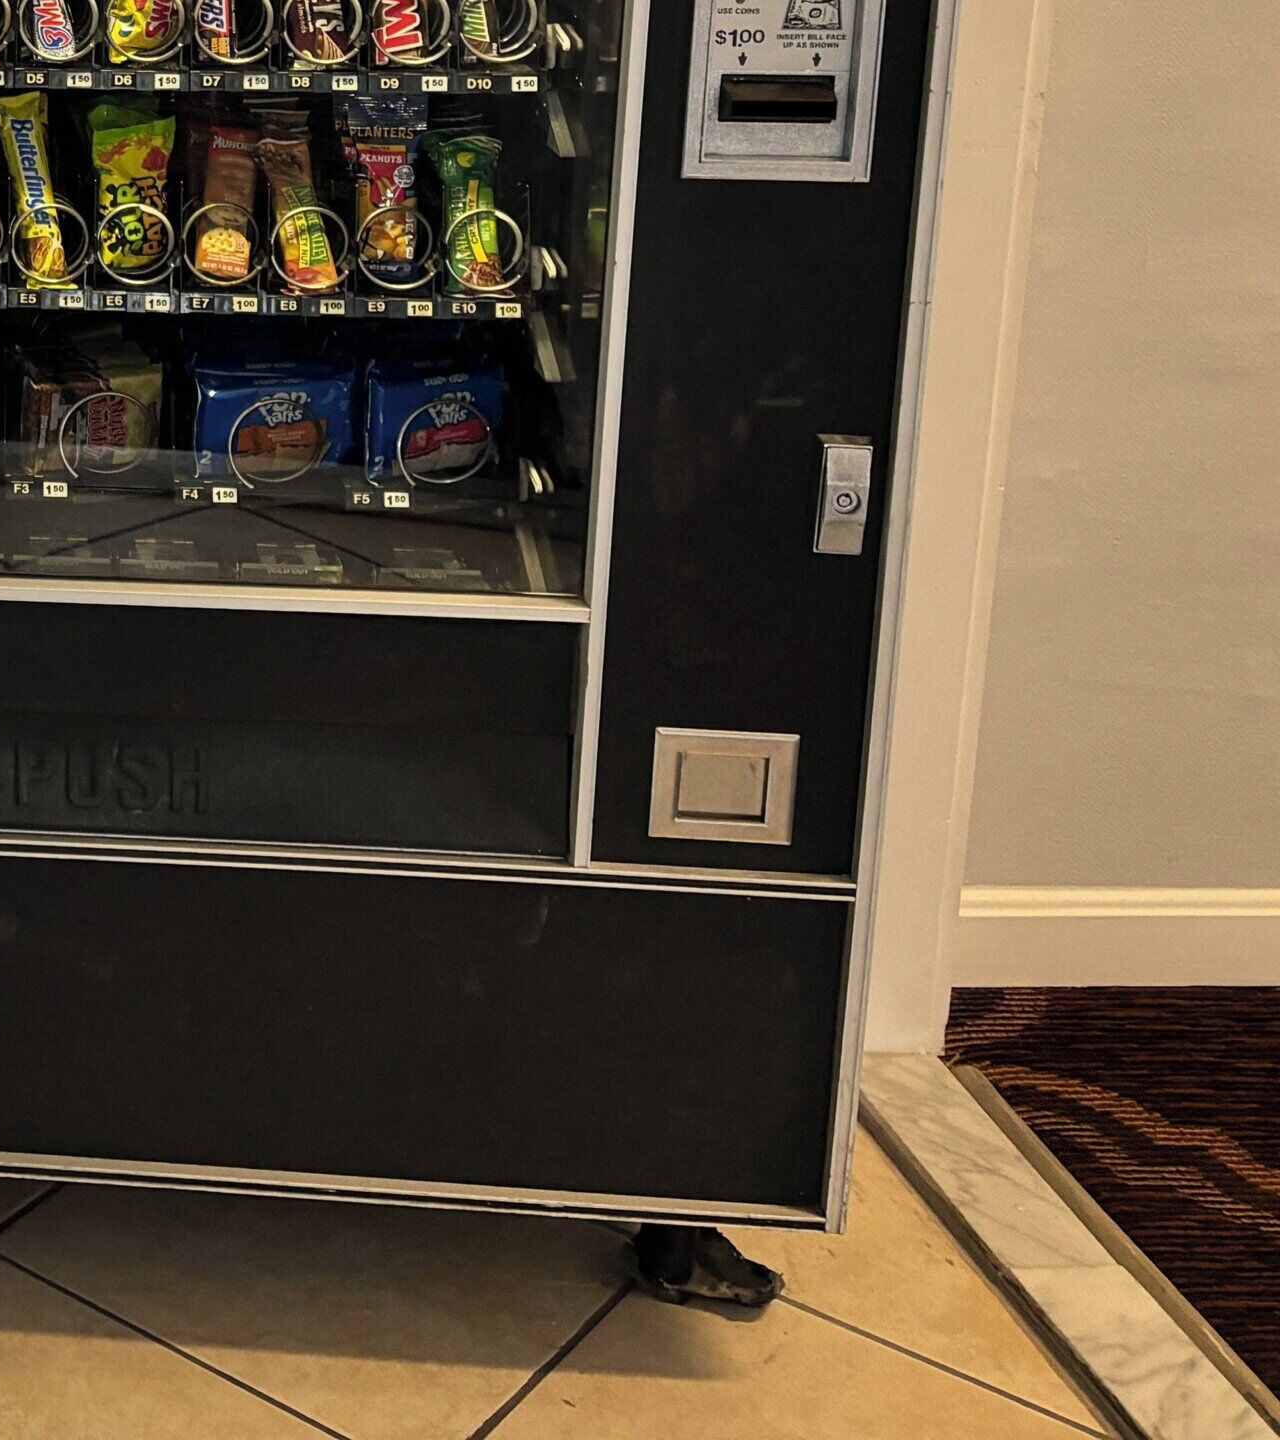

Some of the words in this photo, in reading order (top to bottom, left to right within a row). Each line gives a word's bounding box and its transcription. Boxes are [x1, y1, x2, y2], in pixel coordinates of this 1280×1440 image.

[41, 26, 72, 50] 3
[715, 29, 765, 47] $1.00
[26, 74, 44, 84] D5
[467, 78, 492, 89] D10
[349, 127, 414, 139] PLANTERS
[360, 154, 403, 164] PEANUTS
[10, 118, 51, 228] Butterfinger
[20, 294, 36, 304] E5
[452, 303, 476, 314] E10
